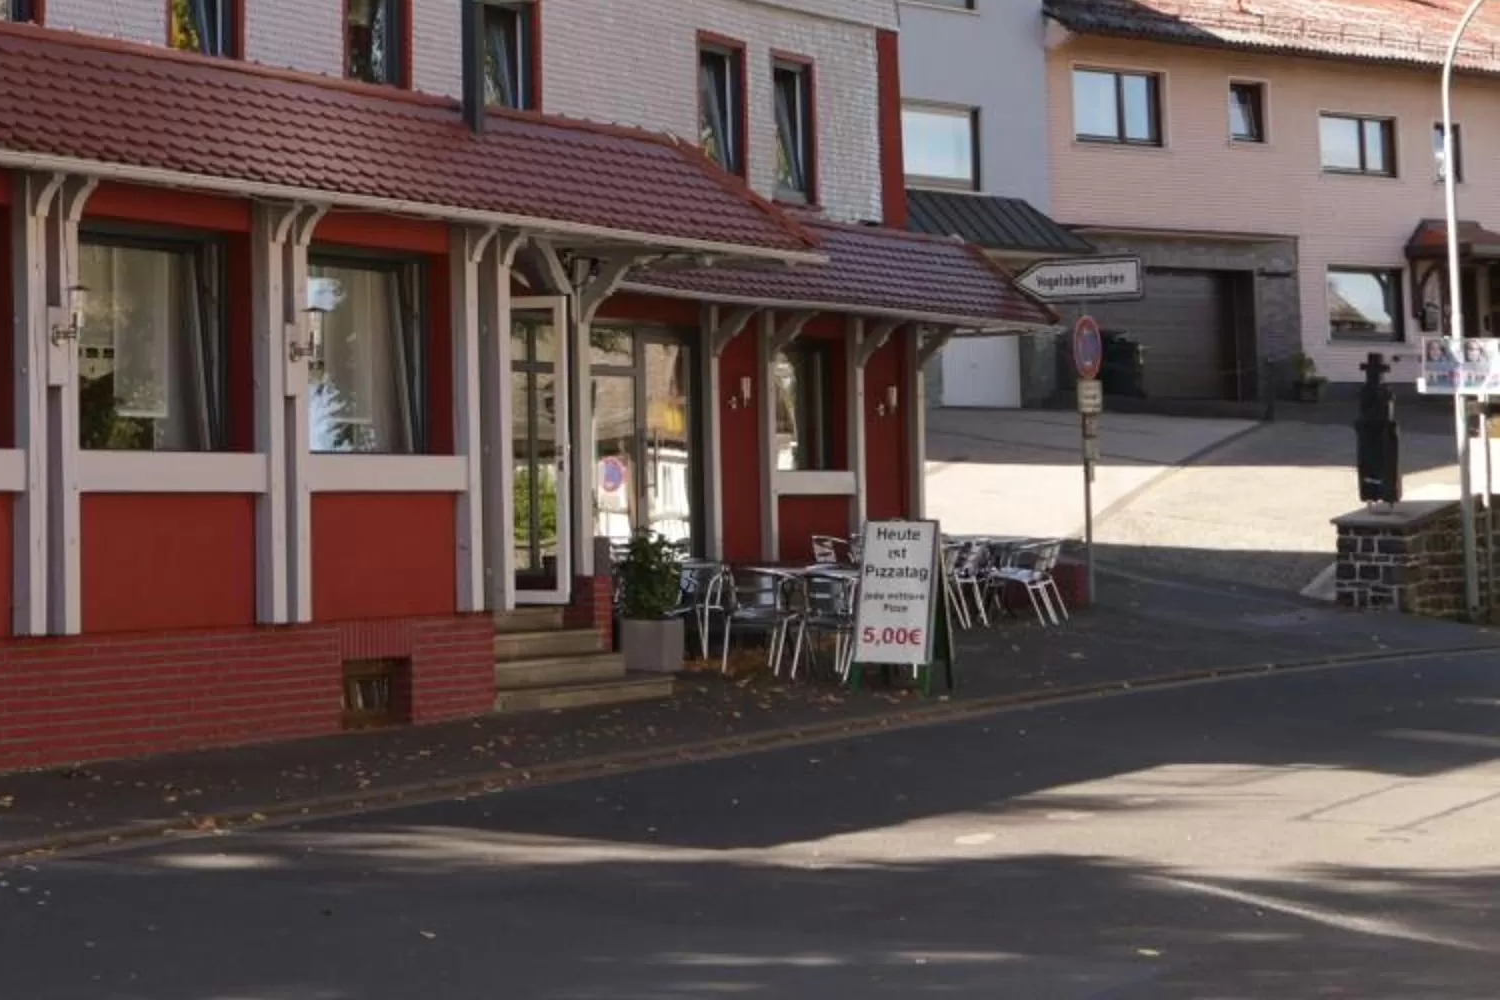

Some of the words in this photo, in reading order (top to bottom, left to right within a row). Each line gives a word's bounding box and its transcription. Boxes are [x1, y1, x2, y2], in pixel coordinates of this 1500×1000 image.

[1035, 272, 1125, 291] Vogelsberggarten
[876, 527, 921, 540] Heute
[887, 547, 907, 559] ist
[864, 564, 929, 581] Pizzatag
[862, 626, 922, 647] 5,00€
